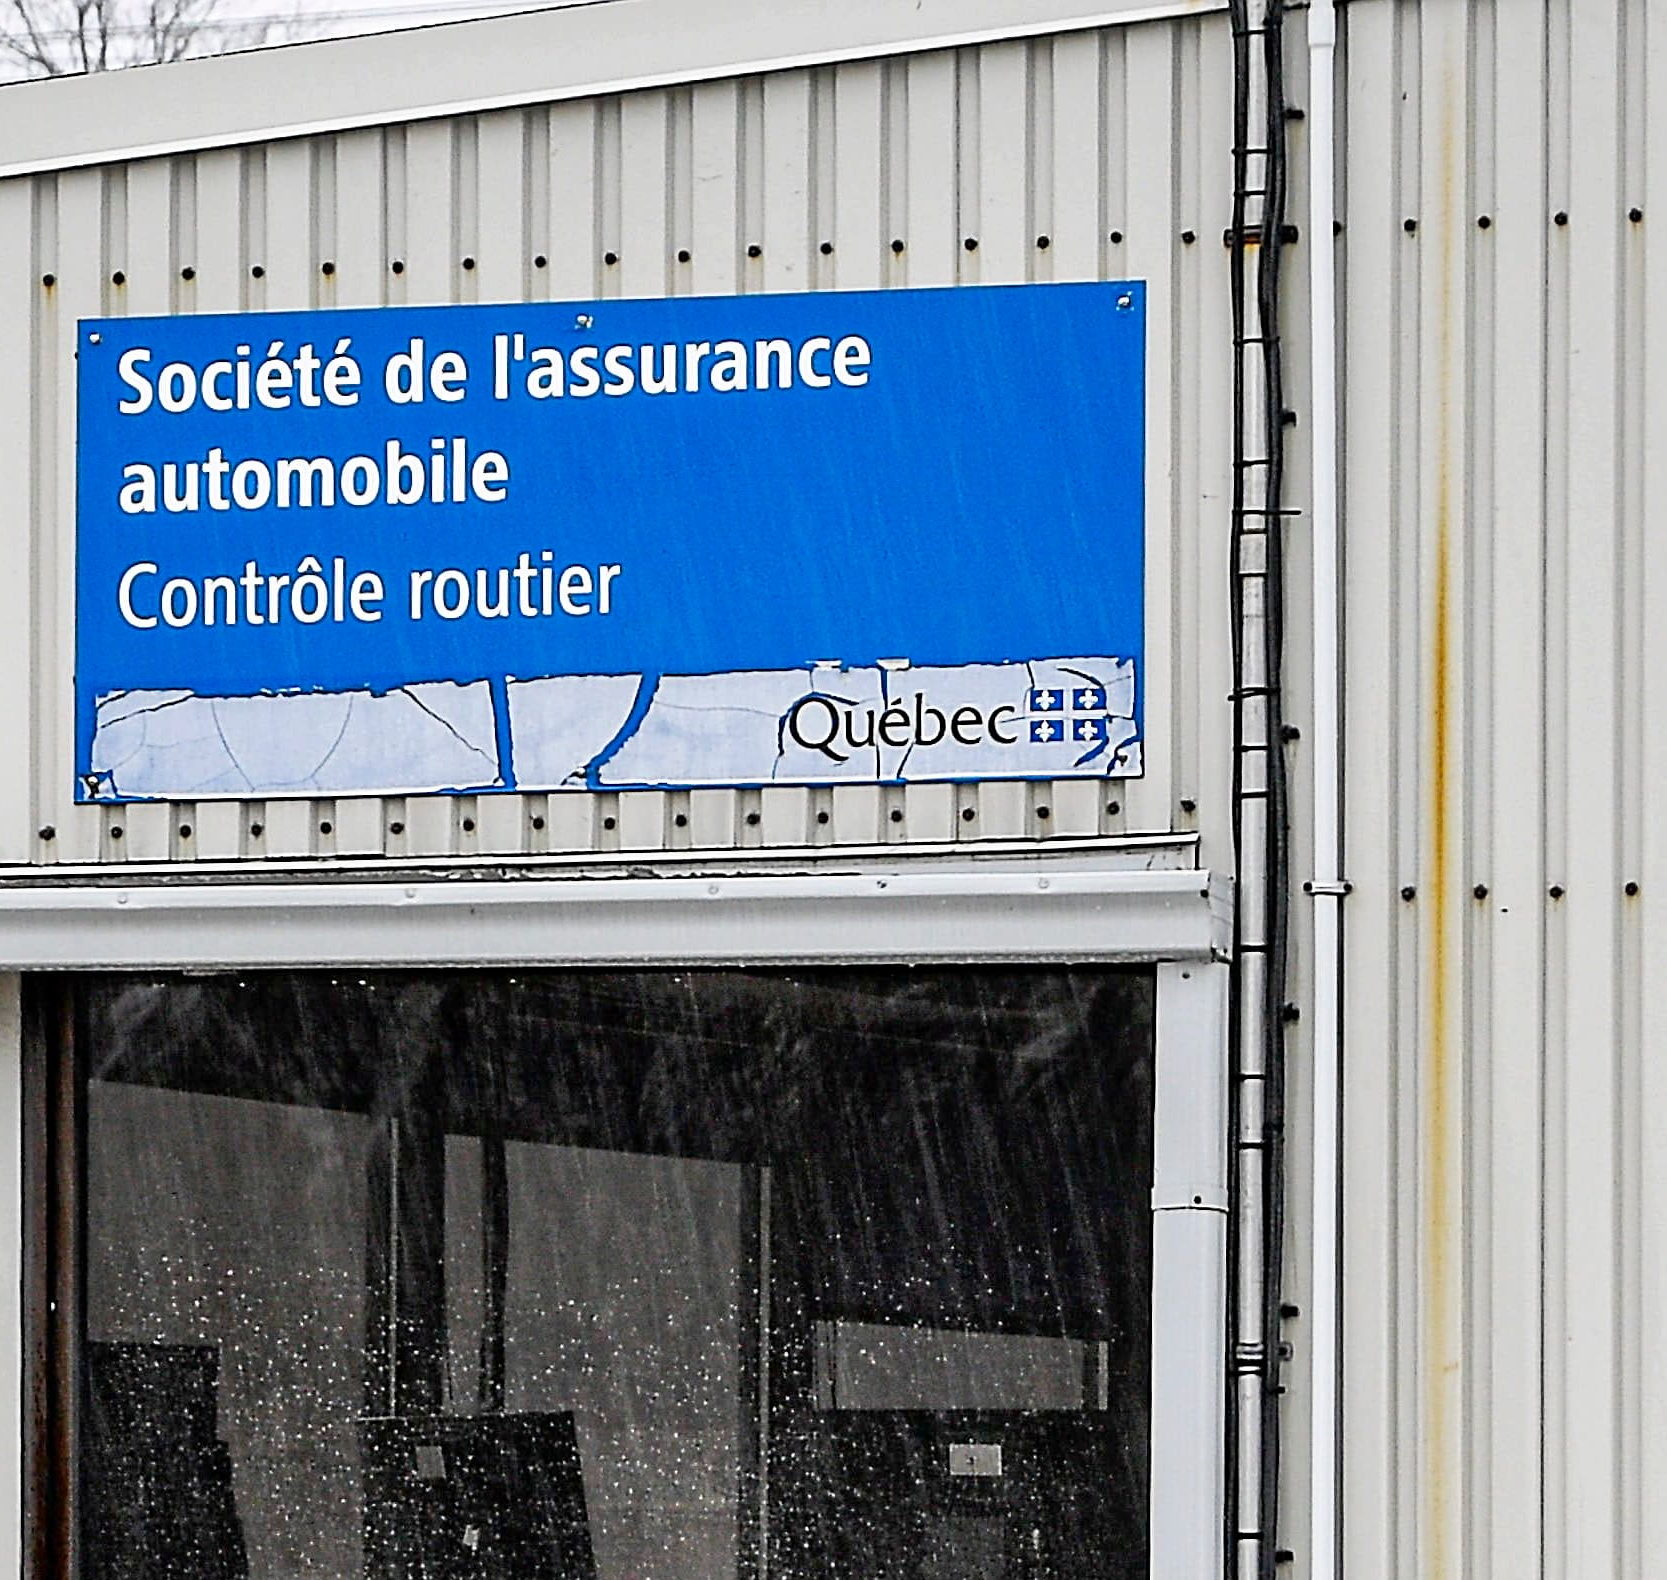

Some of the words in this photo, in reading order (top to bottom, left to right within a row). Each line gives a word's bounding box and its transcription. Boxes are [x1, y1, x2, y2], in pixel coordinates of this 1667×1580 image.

[118, 339, 361, 414] Société
[385, 338, 467, 404] de
[494, 333, 871, 400] l'assurance
[119, 438, 509, 514] automobile
[119, 556, 384, 628] Contrôle
[410, 551, 621, 620] routier
[788, 692, 1018, 761] Québec
